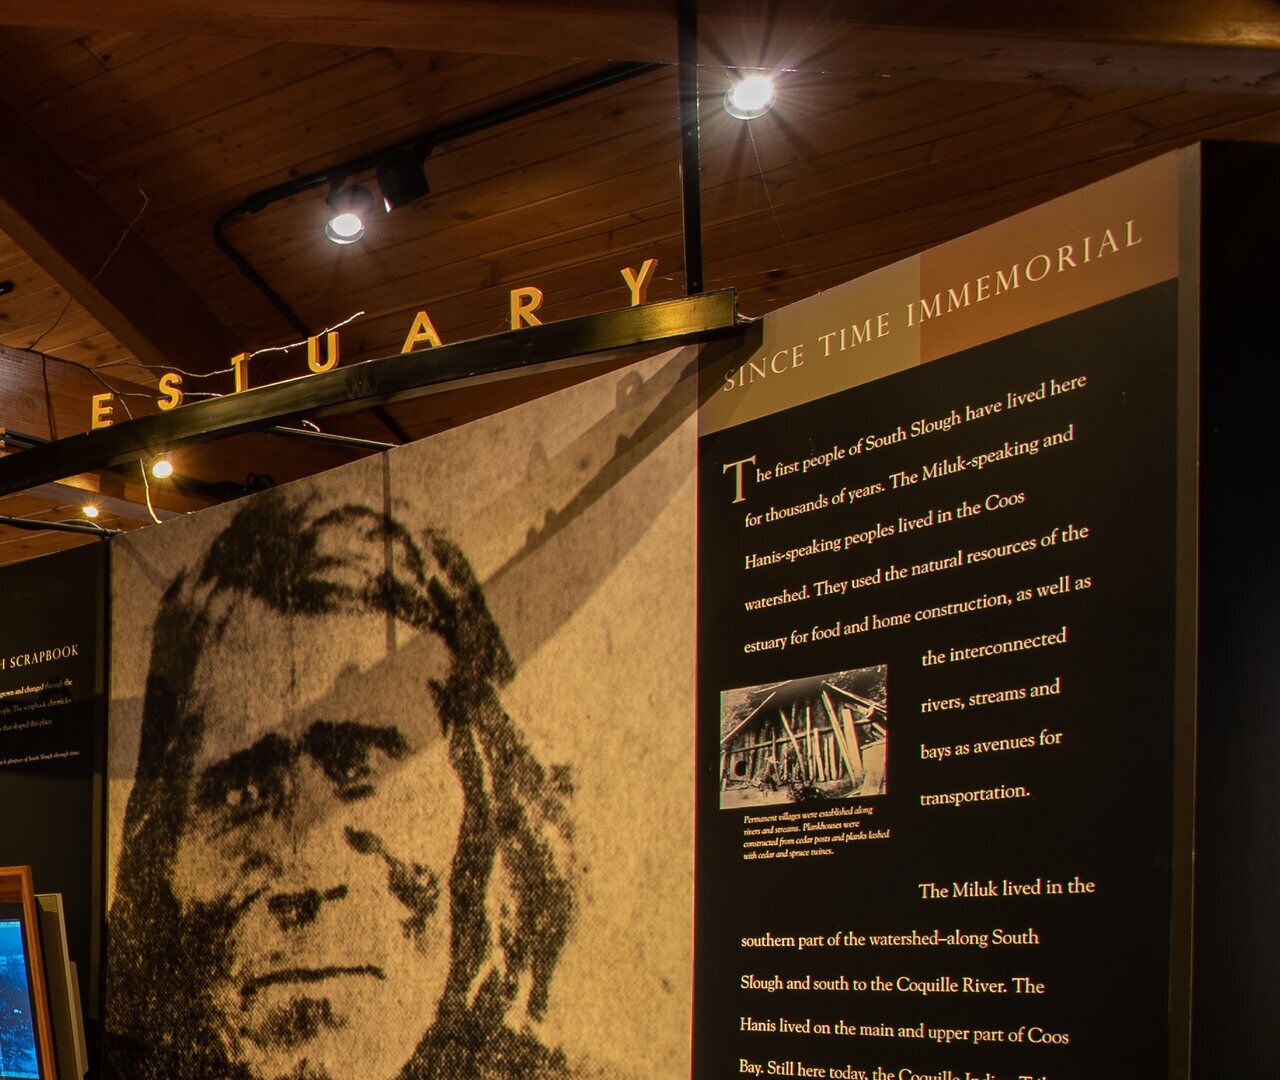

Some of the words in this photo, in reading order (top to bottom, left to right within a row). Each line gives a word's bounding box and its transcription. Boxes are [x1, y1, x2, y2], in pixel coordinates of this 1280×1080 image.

[92, 259, 657, 429] ESTUARY
[723, 346, 804, 393] SINCE
[818, 314, 890, 356] TIME
[908, 221, 1142, 327] IMMEMORIAL
[722, 455, 772, 504] The
[775, 462, 800, 477] first
[803, 448, 845, 473] people
[849, 440, 862, 456] of
[866, 427, 907, 451] South
[911, 411, 962, 437] Slough
[966, 402, 1002, 421] have
[1007, 386, 1046, 409] lived
[1051, 376, 1087, 396] here
[745, 513, 763, 527] for
[765, 494, 829, 522] thousands
[831, 487, 846, 505] of
[848, 483, 886, 504] years.
[889, 471, 918, 489] The
[922, 439, 1039, 481] Miluk-speaking
[1043, 425, 1074, 448] and
[745, 538, 842, 570] Hanis-speaking
[844, 523, 895, 550] peoples
[898, 510, 934, 533] lived
[938, 510, 953, 523] in
[956, 501, 982, 518] the
[985, 492, 1025, 511] Coos
[745, 585, 810, 611] watershed.
[813, 581, 848, 596] They
[852, 570, 882, 589] used
[885, 567, 908, 582] the
[911, 550, 963, 576] natural
[967, 539, 1037, 564] resources
[1040, 528, 1059, 547] of
[1062, 526, 1089, 542] the
[10, 644, 78, 668] SCRAPBOOK
[744, 637, 788, 653] estuary
[790, 630, 809, 645] for
[812, 622, 841, 641] food
[844, 617, 869, 635] and
[872, 613, 912, 629] home
[914, 594, 1013, 621] construction,
[1016, 589, 1033, 602] as
[1036, 577, 1071, 597] well
[1075, 577, 1092, 590] as
[744, 815, 777, 824] Permanent
[778, 812, 801, 821] villages
[818, 807, 853, 818] established
[854, 806, 873, 815] along
